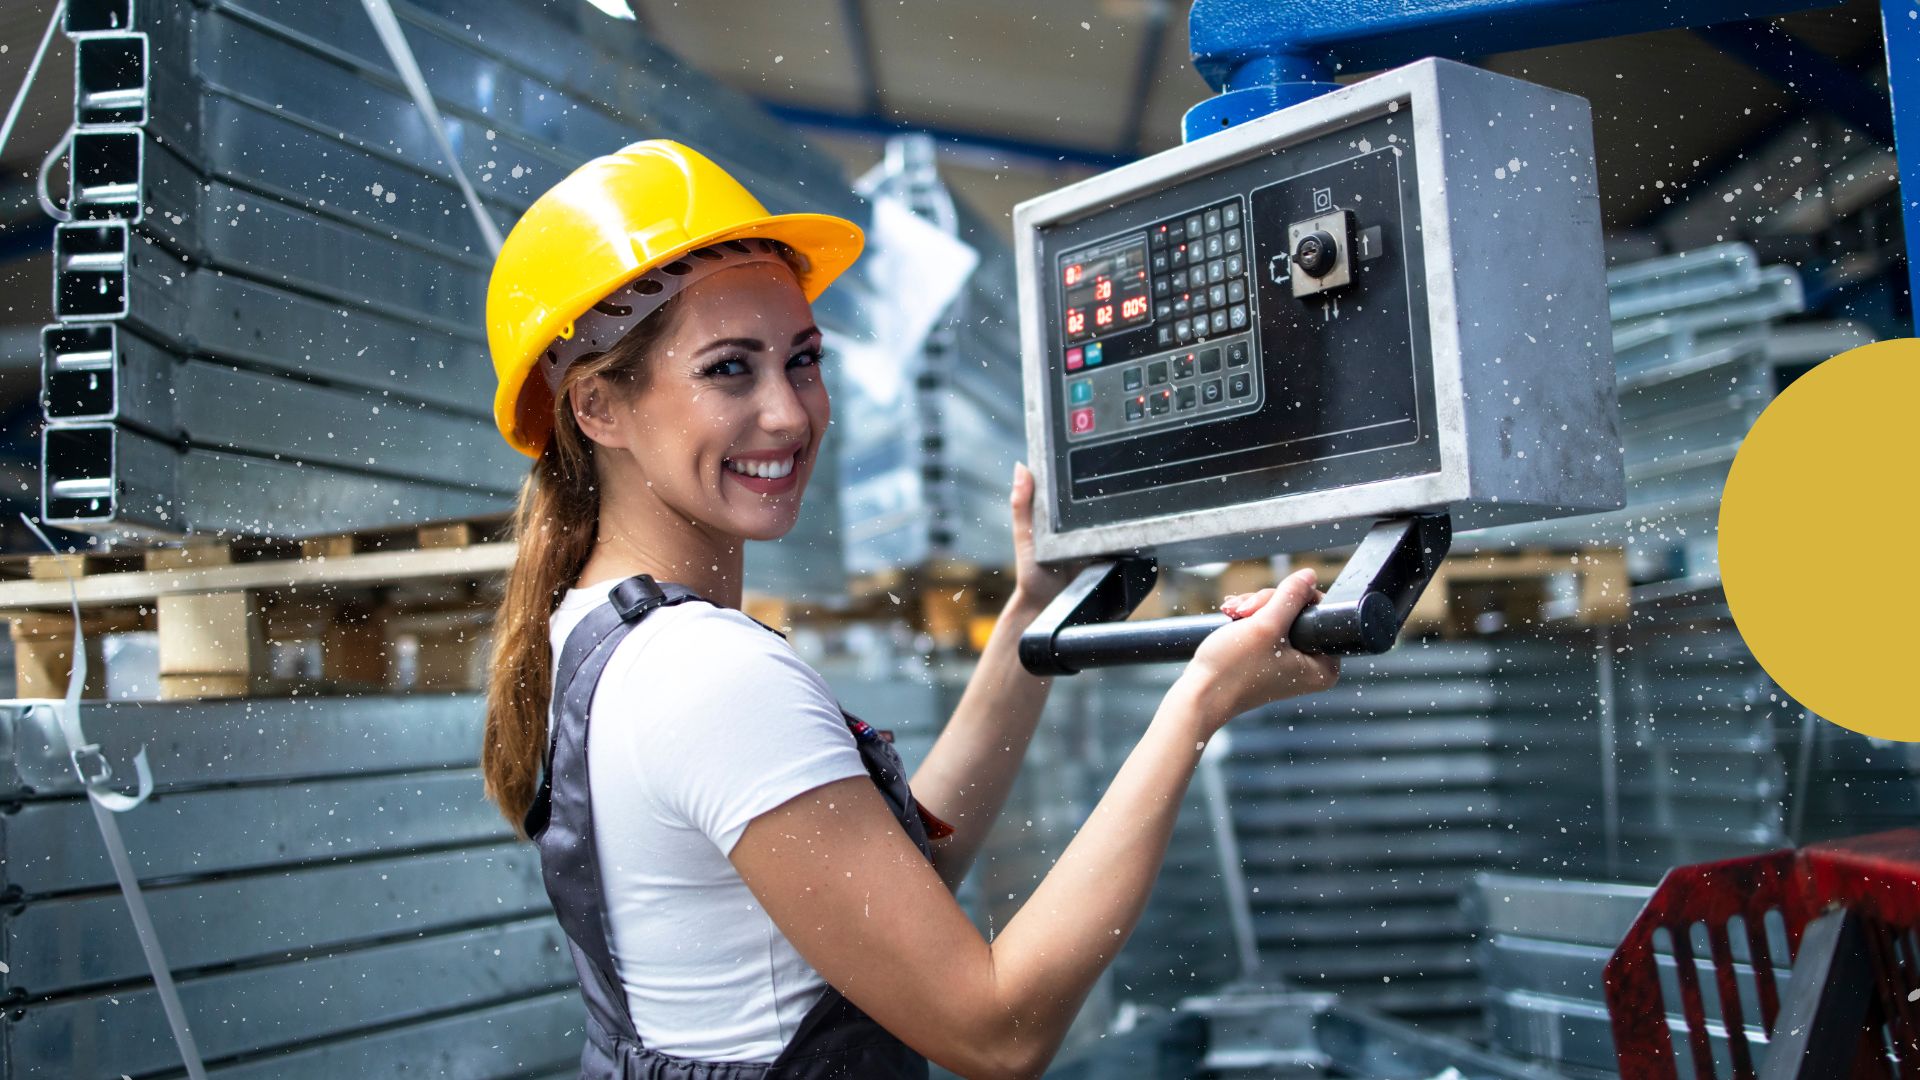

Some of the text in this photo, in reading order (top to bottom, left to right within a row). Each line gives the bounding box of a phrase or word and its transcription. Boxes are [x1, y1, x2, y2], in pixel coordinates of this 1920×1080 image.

[1068, 296, 1147, 333] 02 02 005
[1215, 316, 1223, 327] C
